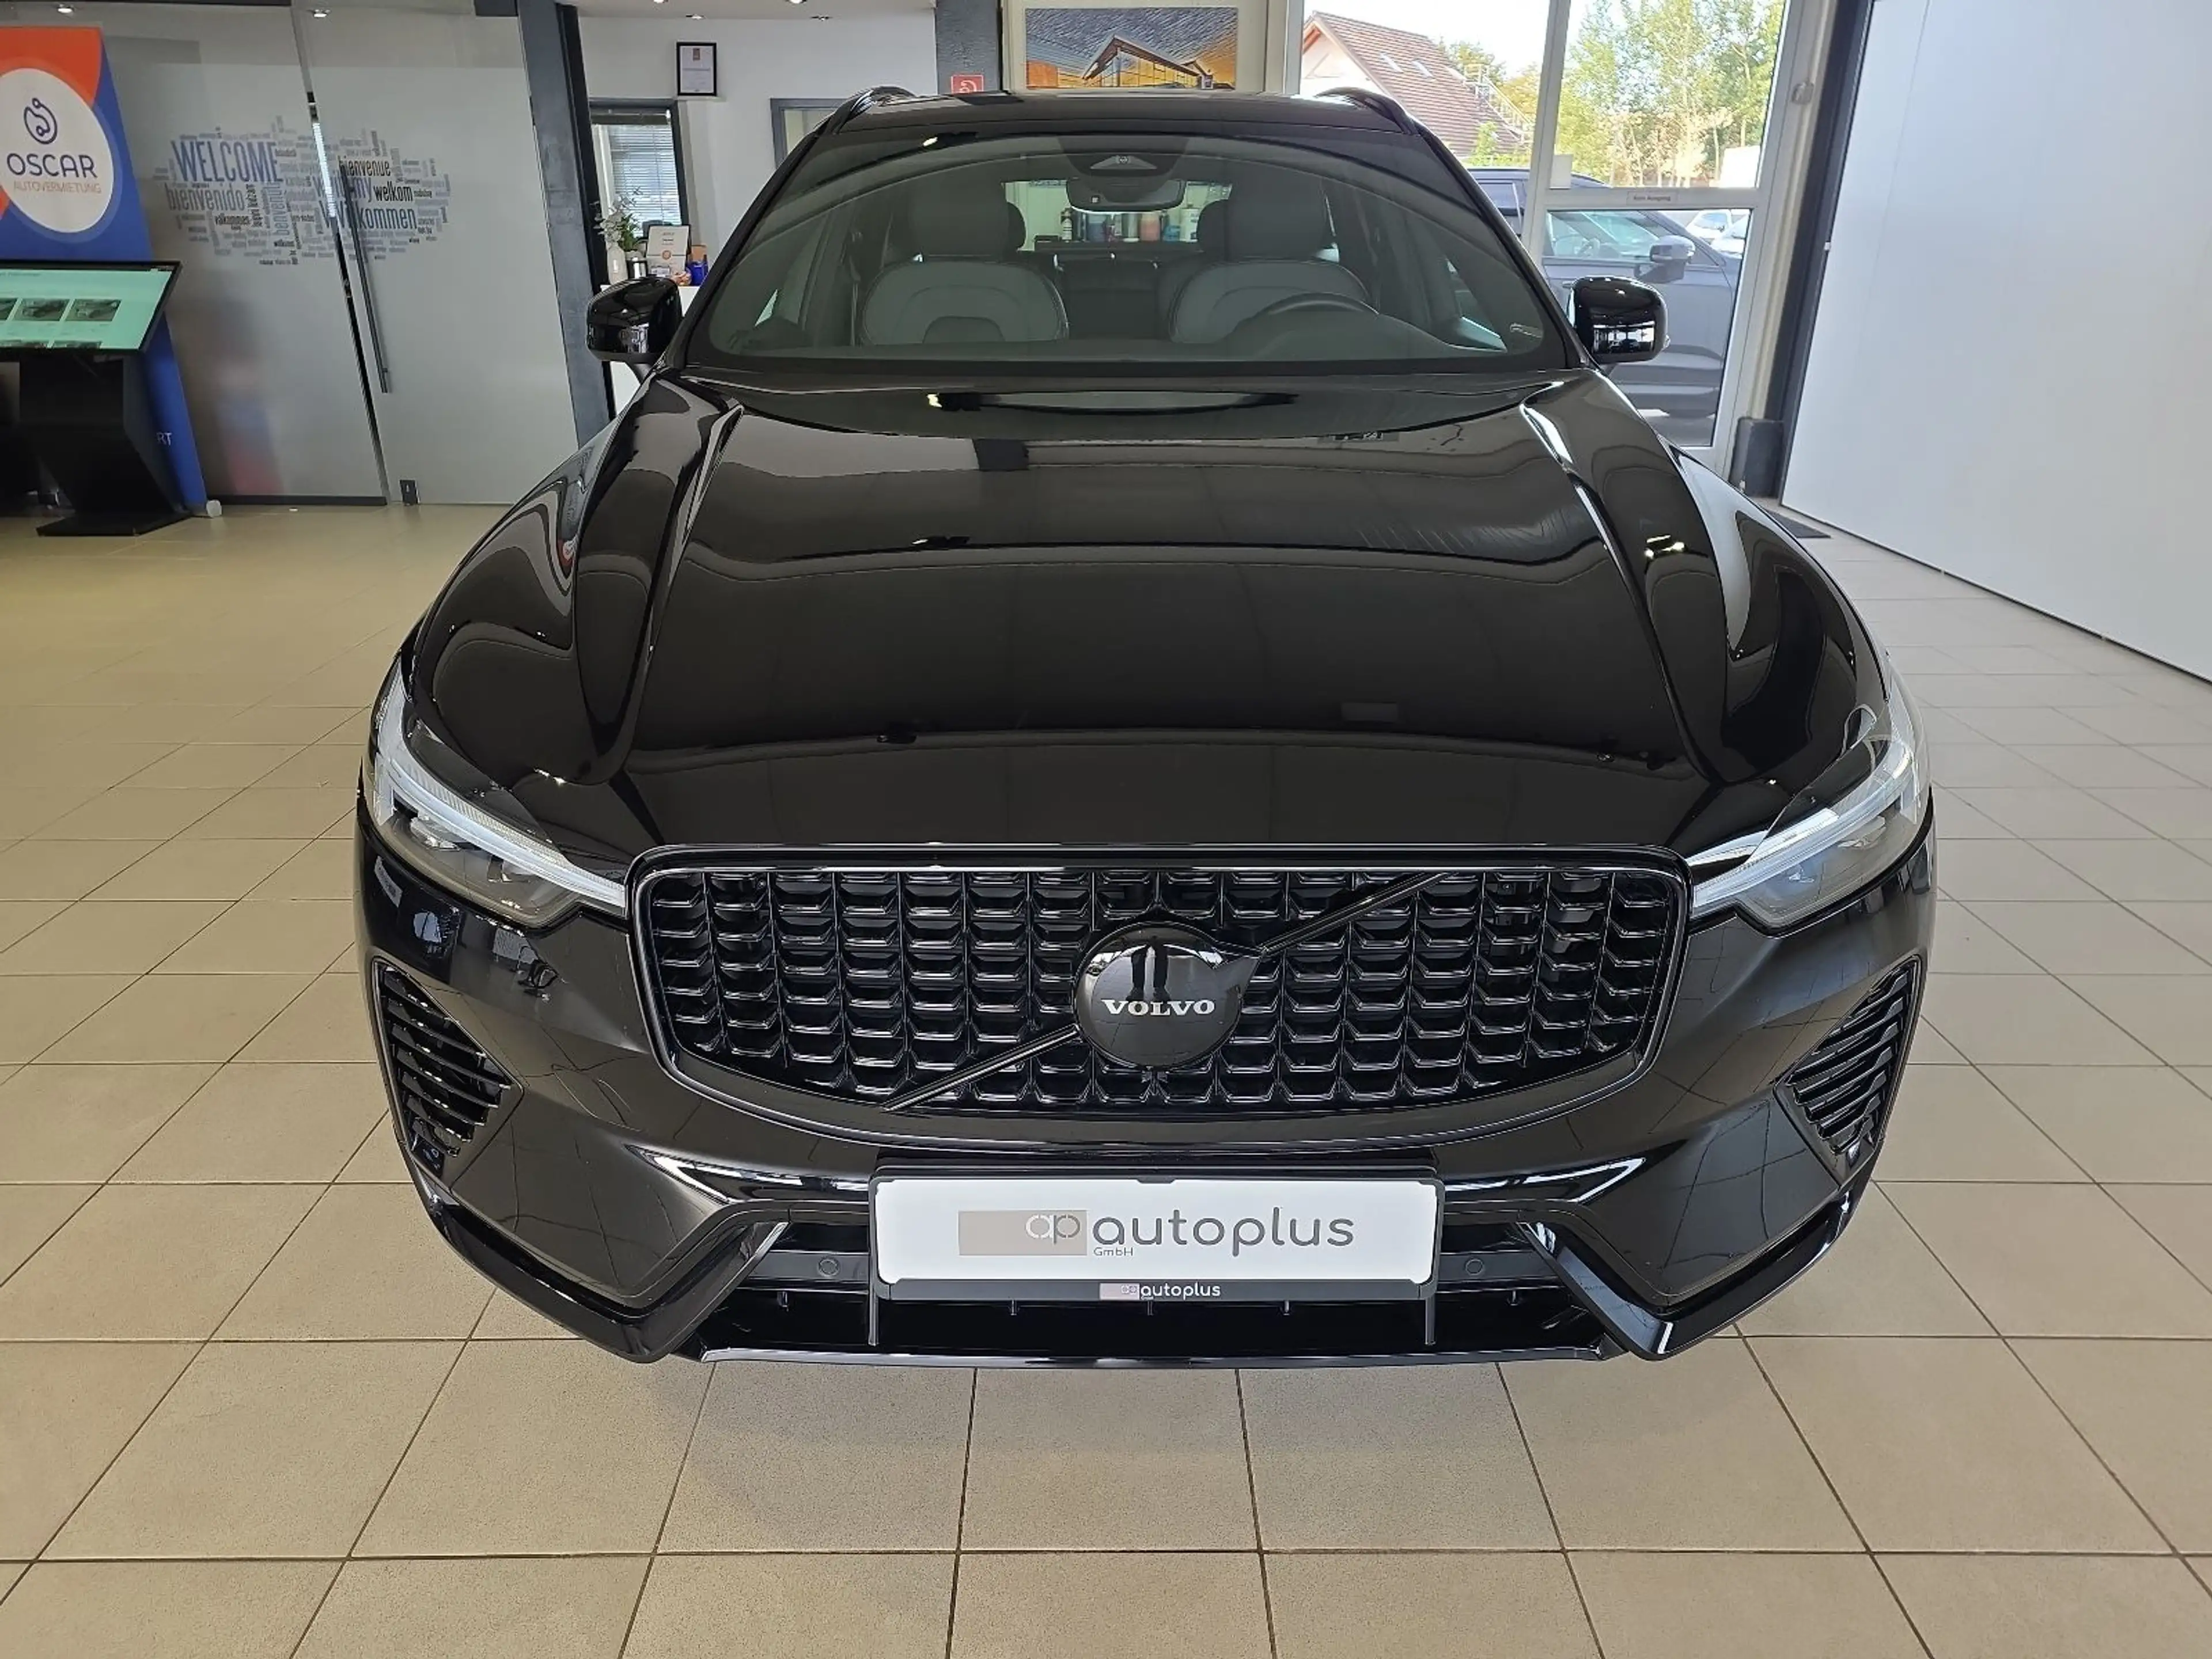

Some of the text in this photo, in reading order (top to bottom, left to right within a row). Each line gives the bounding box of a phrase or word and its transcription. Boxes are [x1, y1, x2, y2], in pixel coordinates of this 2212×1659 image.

[7, 153, 97, 179] OSCAR
[171, 141, 283, 181] WELCOME
[14, 180, 102, 194] AUTOVERMIETUNG
[164, 183, 245, 211] bienvenido
[373, 181, 413, 202] welkom
[1101, 999, 1215, 1017] VOLVO
[1092, 1207, 1355, 1257] autoplus
[1093, 1247, 1134, 1257] GmbH
[1140, 1281, 1221, 1301] autoplus
